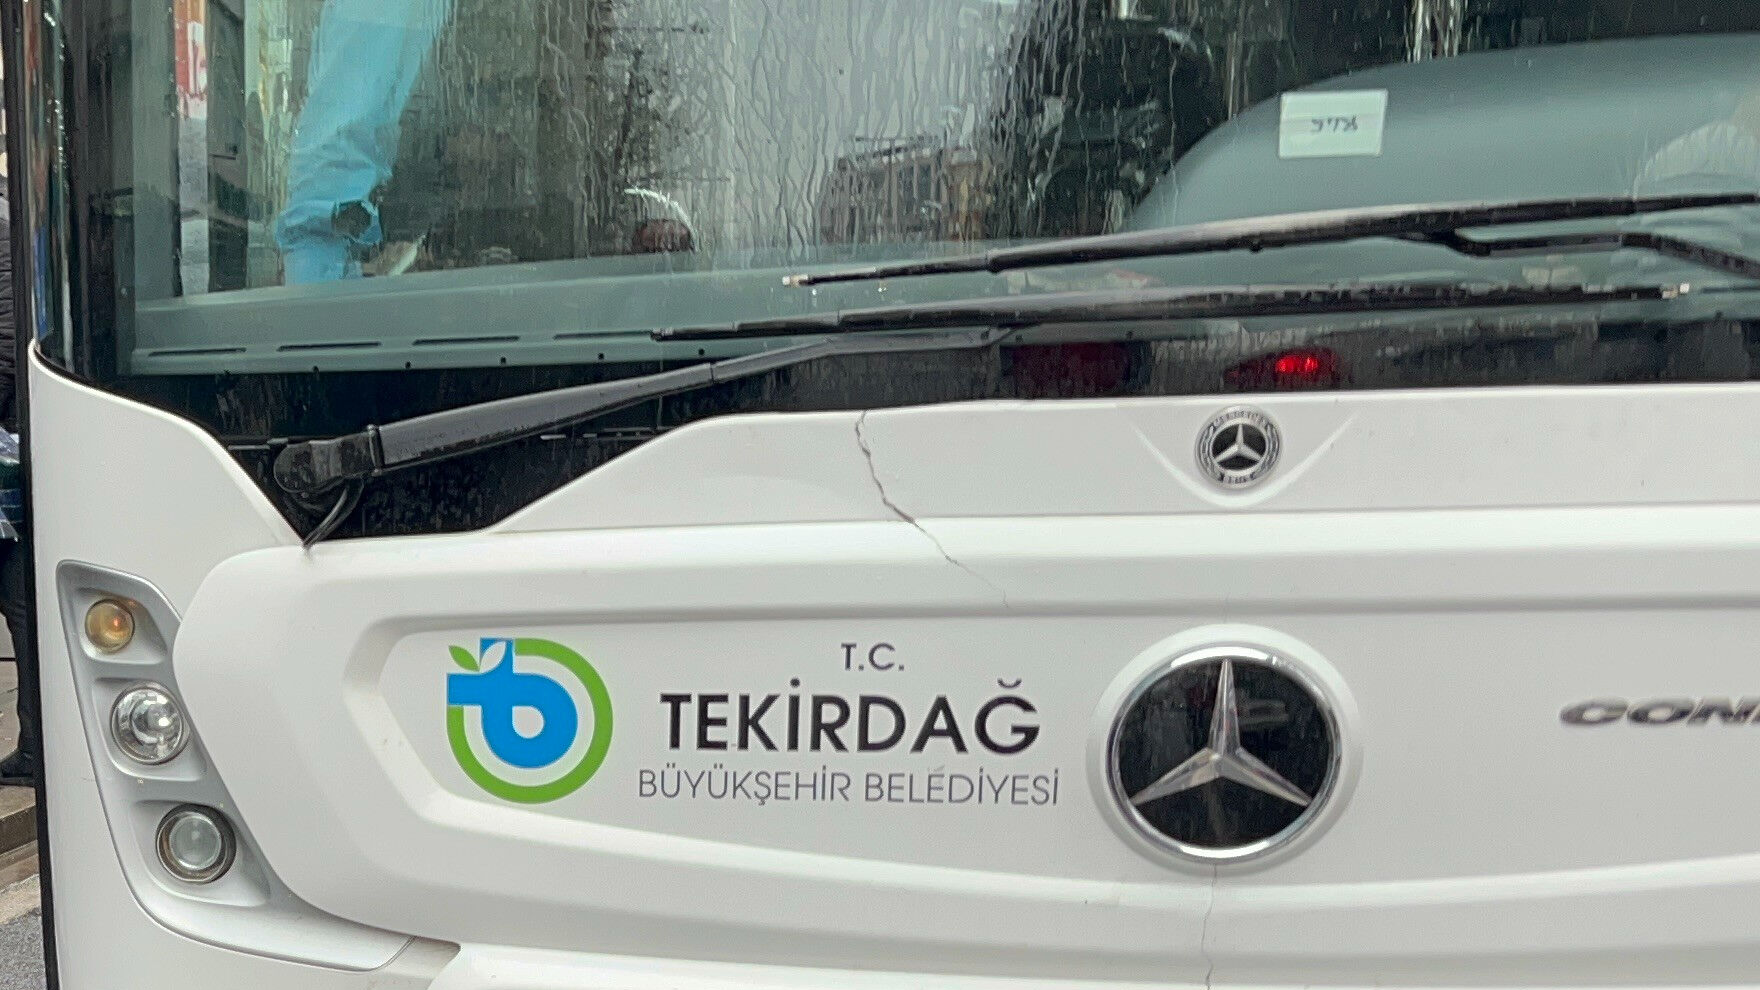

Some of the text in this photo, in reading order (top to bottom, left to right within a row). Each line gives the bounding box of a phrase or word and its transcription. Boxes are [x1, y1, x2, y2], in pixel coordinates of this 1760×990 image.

[841, 642, 906, 672] T.C.
[659, 677, 1041, 756] TEKİRDAĞ
[639, 763, 851, 807] BÜYÜKŞEHİR
